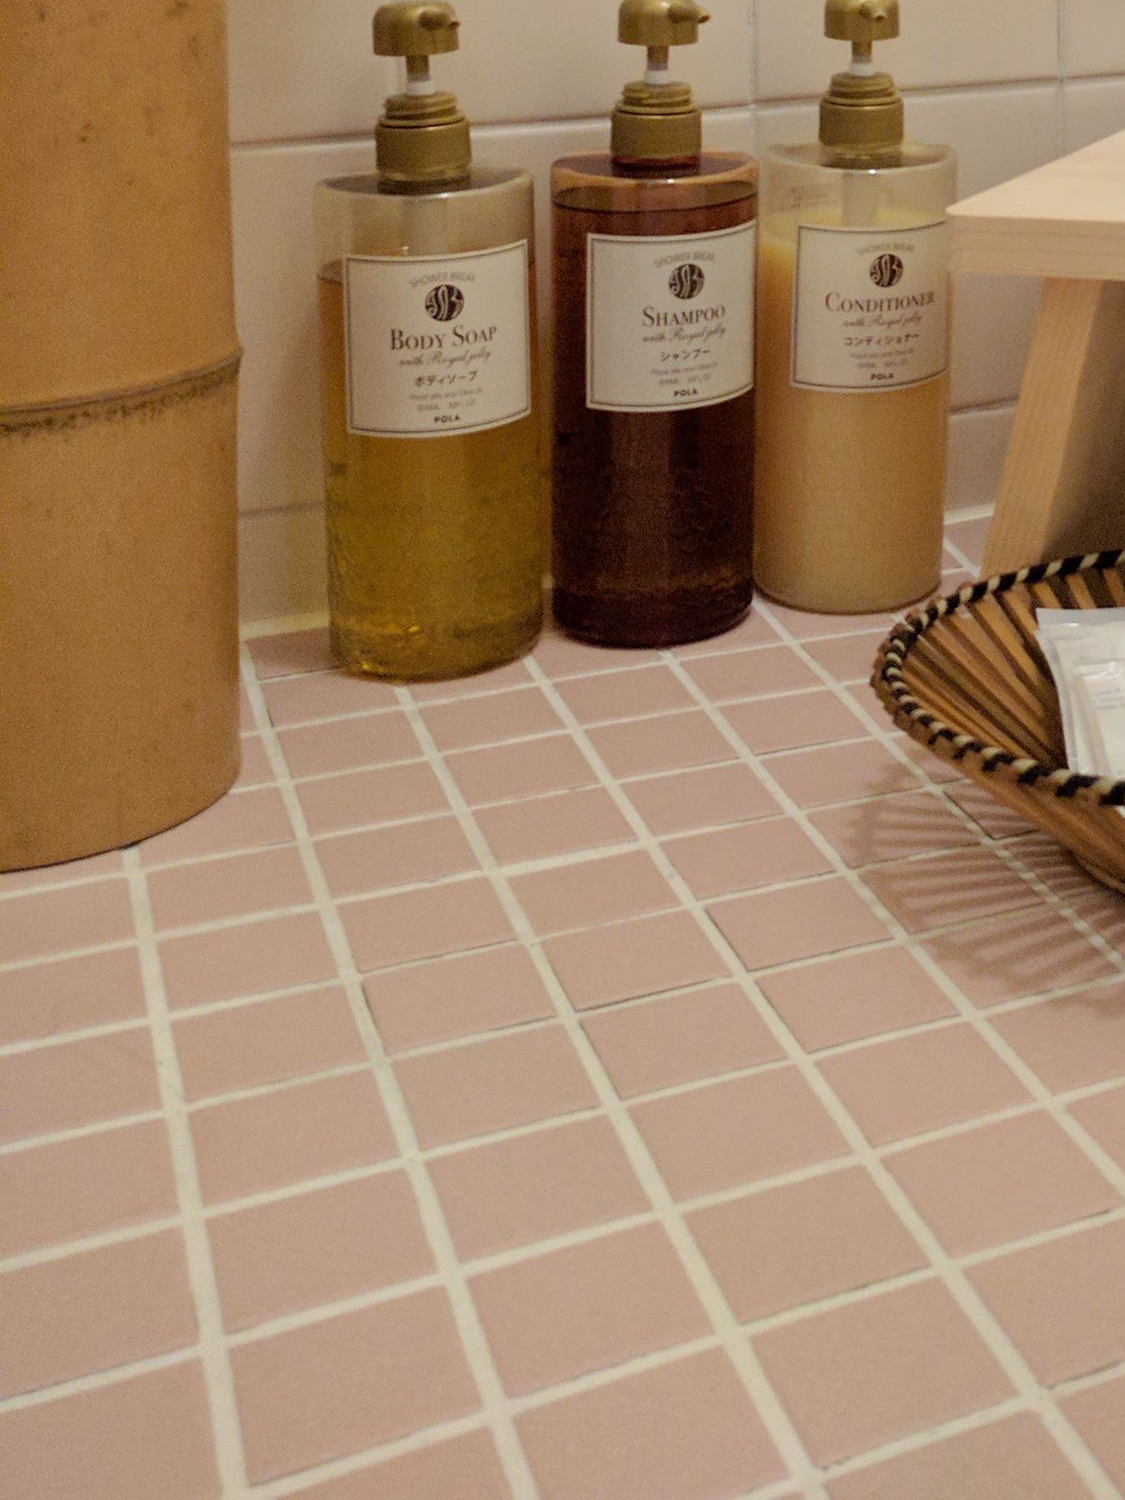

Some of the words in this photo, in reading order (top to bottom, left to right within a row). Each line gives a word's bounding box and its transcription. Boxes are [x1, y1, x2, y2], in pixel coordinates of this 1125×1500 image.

[824, 290, 936, 314] CONDITIONER
[641, 303, 727, 328] SHAMPOO
[389, 328, 446, 351] BODY
[452, 323, 498, 347] SOAP
[415, 369, 479, 388] ボディソープ
[673, 387, 698, 397] POLA
[434, 414, 461, 424] POLA
